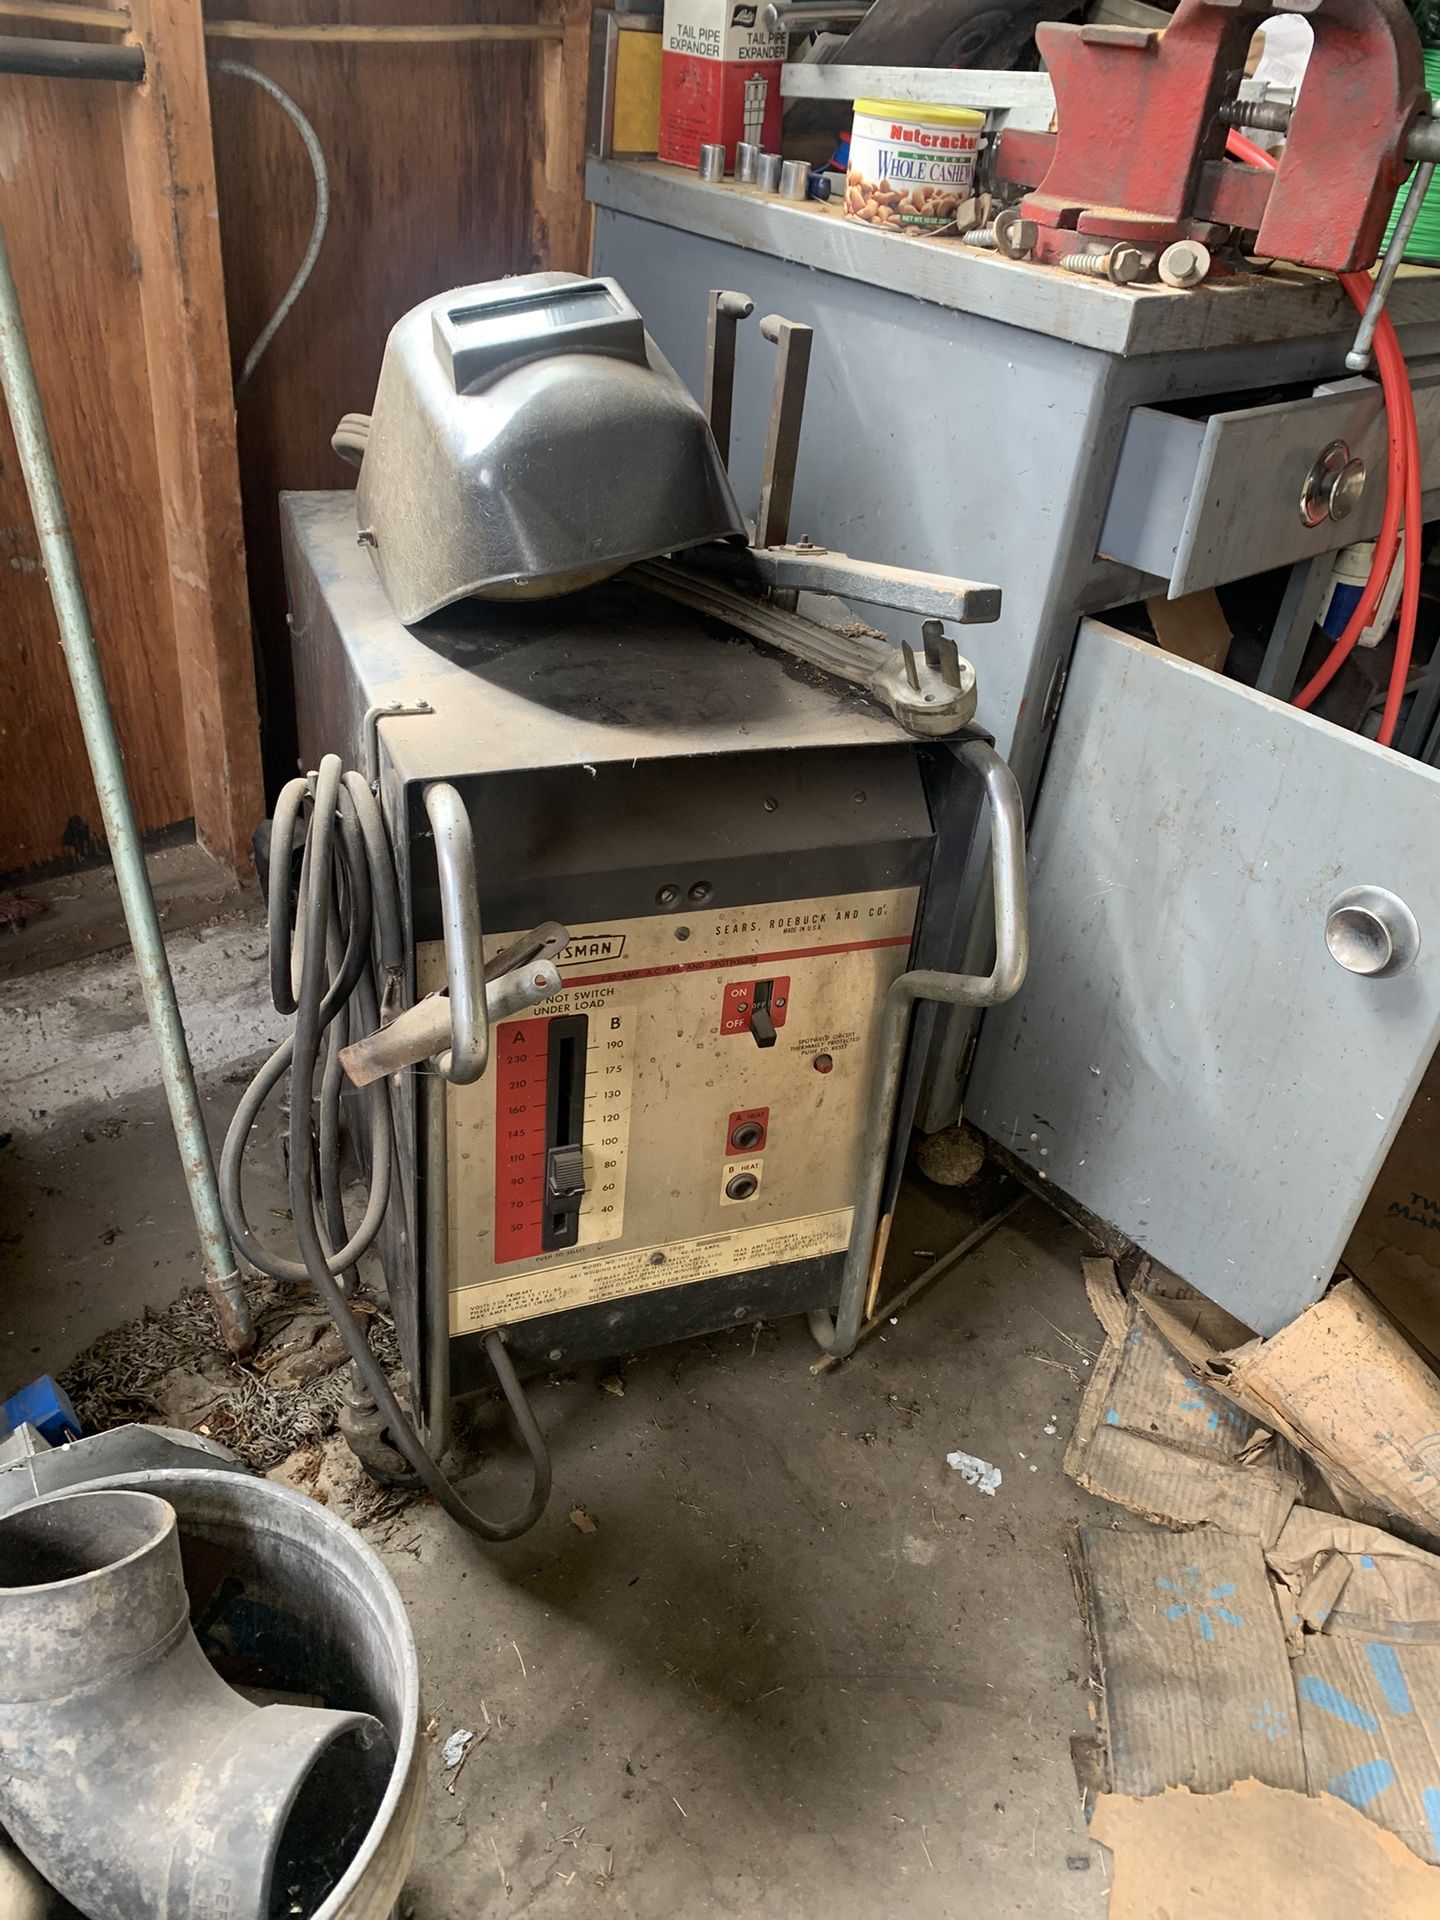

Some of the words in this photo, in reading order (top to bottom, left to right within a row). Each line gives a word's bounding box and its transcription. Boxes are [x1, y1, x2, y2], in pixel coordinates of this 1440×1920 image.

[677, 24, 696, 39] TAIL
[699, 28, 720, 43] PIPE
[747, 32, 765, 44] TAIL
[768, 32, 786, 44] PIPE
[670, 37, 719, 57] EXPANDER
[739, 46, 785, 59] EXPANDER
[878, 149, 926, 180] WHOLE
[716, 922, 761, 936] SEARS,
[770, 914, 826, 929] ROEBUCK
[836, 910, 858, 921] AND
[687, 962, 704, 970] AND
[710, 955, 758, 968] SPOTWELDER
[546, 994, 569, 1005] NOT
[574, 988, 614, 1000] SWITCH
[731, 989, 747, 998] ON
[534, 1005, 570, 1016] UNDER
[575, 1000, 605, 1010] LOAD
[611, 1017, 621, 1029] B
[726, 1019, 745, 1028] OFF
[513, 1031, 525, 1045] A
[799, 1035, 829, 1044] SPOTWELD
[833, 1032, 855, 1040] CIRCUIT
[607, 1040, 624, 1049] 190
[790, 1043, 824, 1052] THERMALLY
[828, 1036, 860, 1045] PROTECTED
[507, 1055, 527, 1064] 230
[605, 1065, 622, 1074] 175
[509, 1080, 526, 1090] 210
[604, 1089, 620, 1099] 130
[508, 1105, 526, 1114] 160
[602, 1113, 619, 1123] 120
[747, 1112, 764, 1120] HEAT
[508, 1129, 525, 1139] 145
[601, 1137, 618, 1146] 100
[510, 1154, 525, 1163] 110
[604, 1160, 616, 1168] 80
[741, 1163, 759, 1171] HEAT
[511, 1177, 524, 1186] 90
[602, 1183, 615, 1191] 60
[510, 1201, 523, 1209] 70
[601, 1205, 613, 1213] 40
[511, 1223, 523, 1232] 50
[767, 1233, 798, 1243] SECONDARY
[583, 1267, 611, 1275] WELDING
[594, 1274, 620, 1282] PRIMARY
[602, 1274, 637, 1285] SECONDARY
[589, 1284, 613, 1292] NUMBER
[506, 1289, 532, 1298] PRIMARY
[470, 1303, 489, 1311] VOLTS
